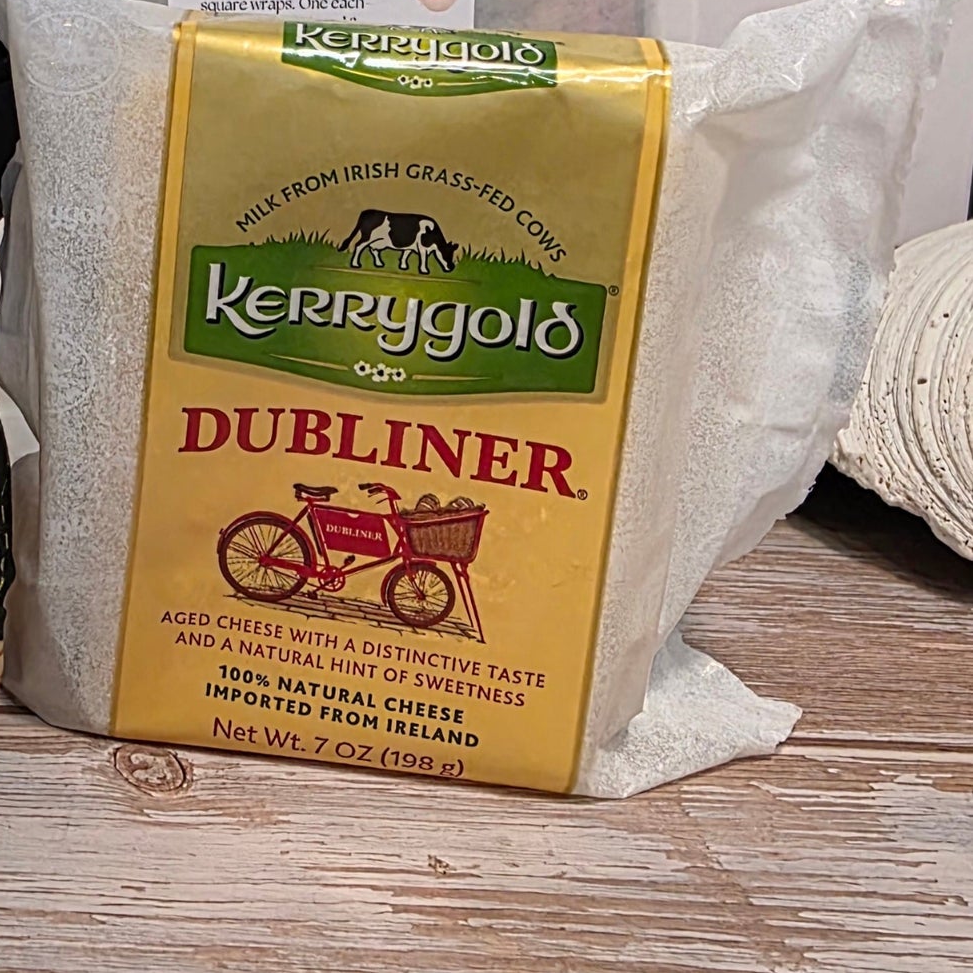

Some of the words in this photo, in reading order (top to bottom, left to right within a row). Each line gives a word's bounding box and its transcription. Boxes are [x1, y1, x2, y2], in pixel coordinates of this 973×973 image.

[200, 0, 248, 16] square
[250, 0, 295, 15] wraps.
[235, 194, 282, 232] MILK
[280, 168, 339, 203] FROM
[343, 162, 399, 183] IRISH
[405, 163, 515, 213] GRASS-FED
[516, 210, 567, 263] COWS
[326, 523, 383, 542] DUBLINER
[161, 611, 211, 626] AGED
[216, 615, 284, 639] CHEESE
[289, 627, 338, 650] WITH
[343, 638, 356, 654] A
[362, 641, 481, 676] DISTINCTIVE
[487, 664, 546, 689] TASTE
[175, 631, 215, 648] AND
[220, 637, 233, 652] A
[239, 640, 325, 670] NATURAL
[330, 657, 378, 679] HINT
[383, 668, 409, 684] OF
[413, 673, 526, 707] SWEETNESS
[205, 682, 312, 717] IMPORTED
[319, 706, 379, 731] FROM
[386, 718, 480, 749] IRELAND
[219, 664, 270, 688] 100%
[277, 676, 377, 709] NATURAL
[384, 697, 465, 725] CHEESE
[212, 716, 259, 744] Net
[264, 725, 307, 752] Wt.
[313, 736, 330, 755] 7
[334, 740, 375, 763] OZ
[380, 746, 435, 771] (198
[439, 758, 465, 778] g)
